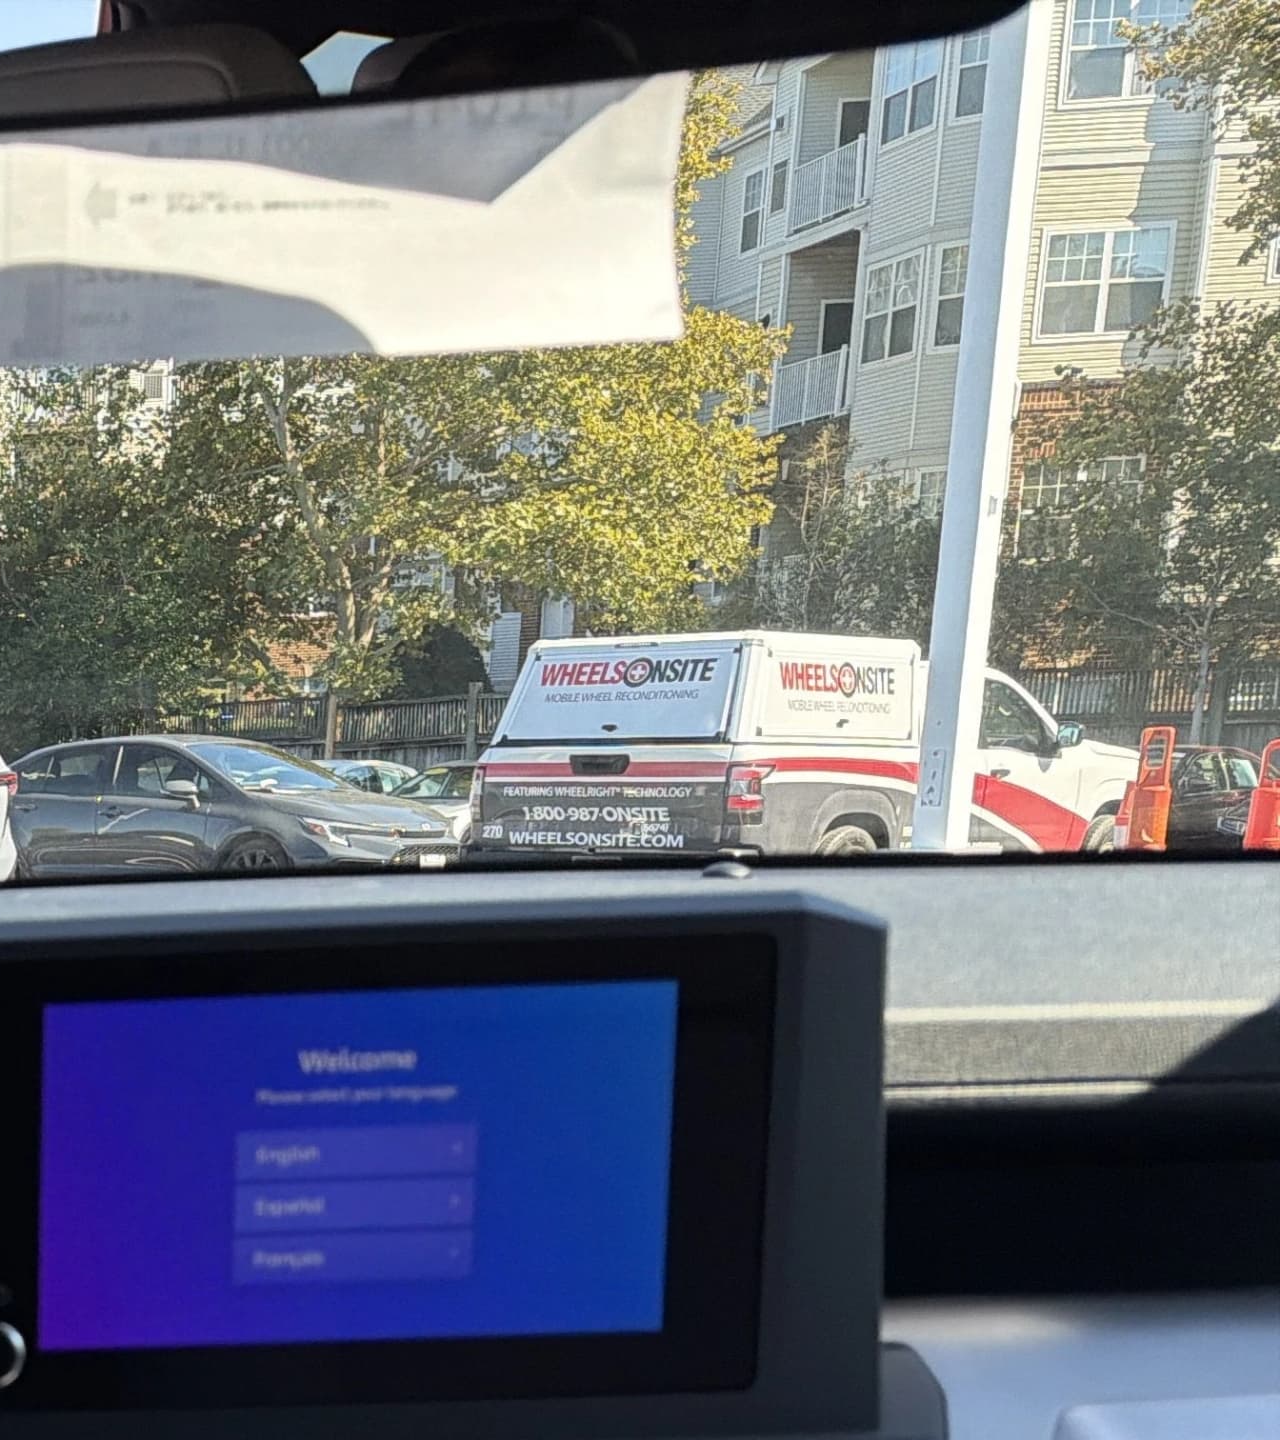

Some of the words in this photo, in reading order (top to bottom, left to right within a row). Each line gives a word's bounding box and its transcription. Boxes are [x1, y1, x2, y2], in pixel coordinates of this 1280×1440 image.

[540, 657, 719, 688] WHEELSONSITE
[779, 661, 896, 698] WHEELSONSITE
[544, 692, 580, 703] MOBILE
[581, 691, 614, 702] WHEEL
[614, 688, 700, 702] RECONDITIONING
[503, 786, 553, 798] FEATURING
[622, 786, 692, 799] TECHNOLOGY
[482, 824, 504, 839] 270
[508, 831, 685, 848] WHEELSONSITE.COM
[297, 1047, 418, 1074] Welcome
[255, 1145, 320, 1167] English
